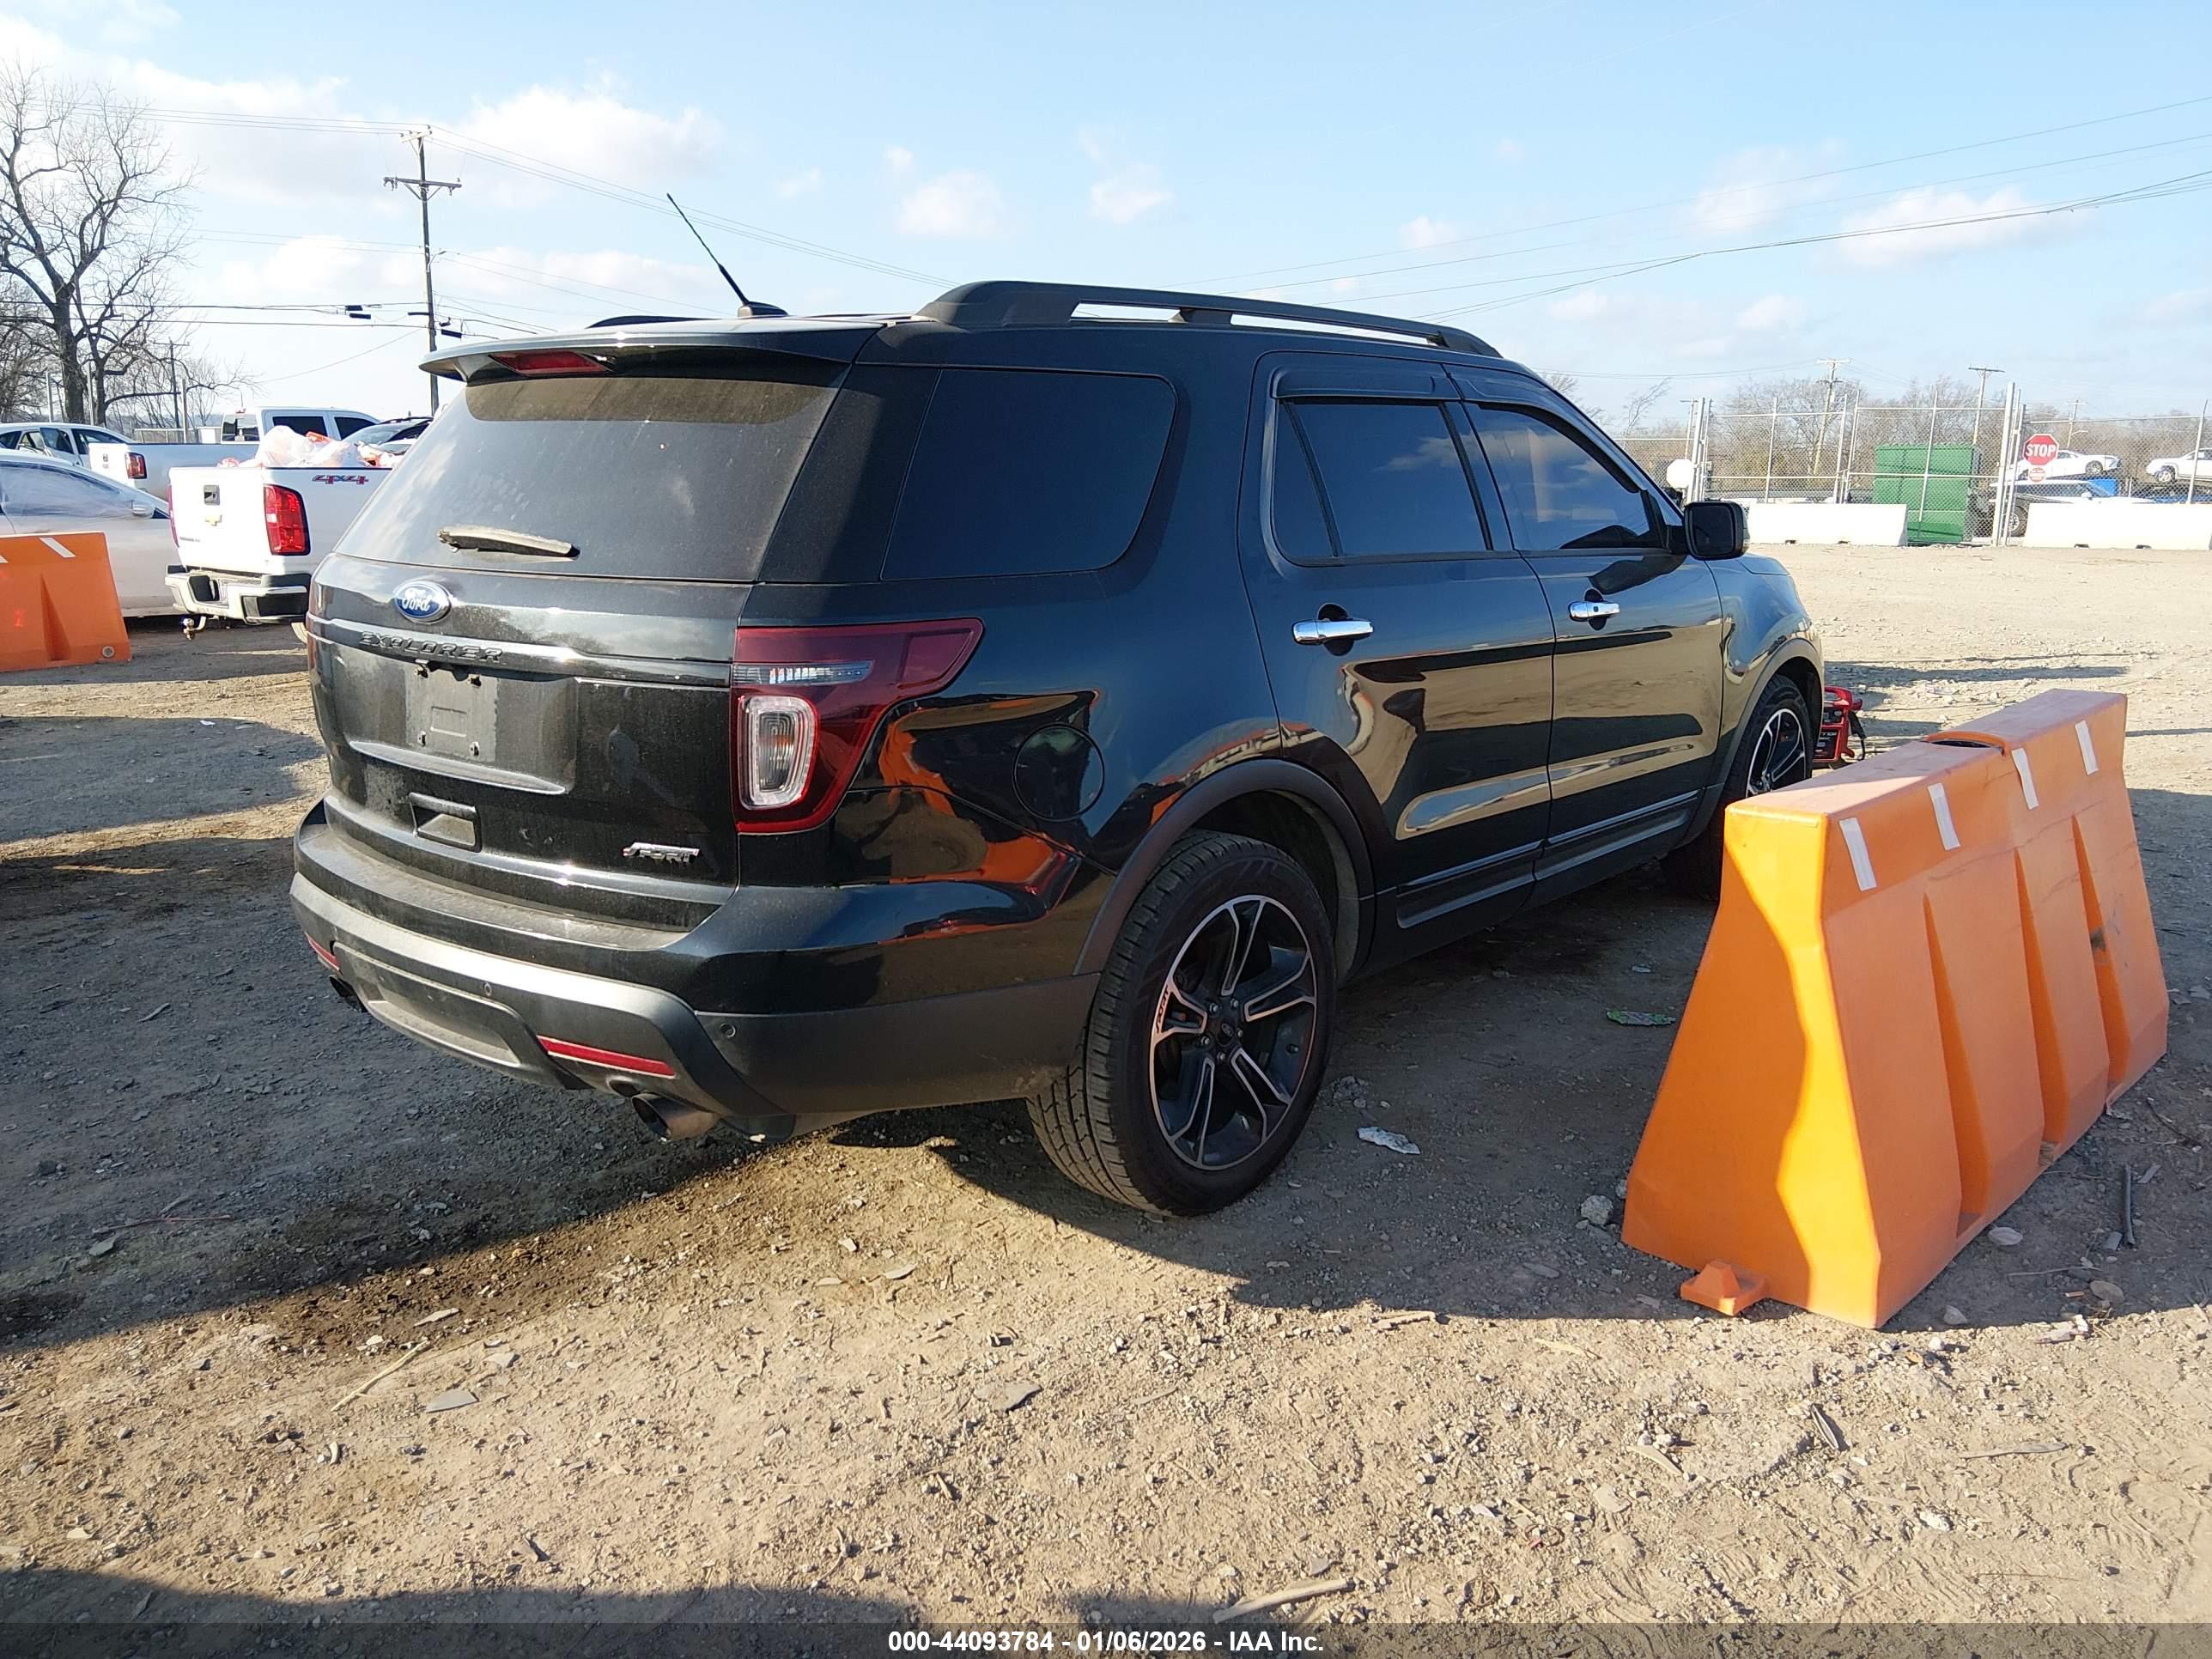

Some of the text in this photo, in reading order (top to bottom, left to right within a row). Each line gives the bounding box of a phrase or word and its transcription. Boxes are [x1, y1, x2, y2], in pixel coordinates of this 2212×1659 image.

[2026, 443, 2057, 457] STOP
[402, 587, 434, 612] Ford
[359, 631, 504, 663] EXPLORER
